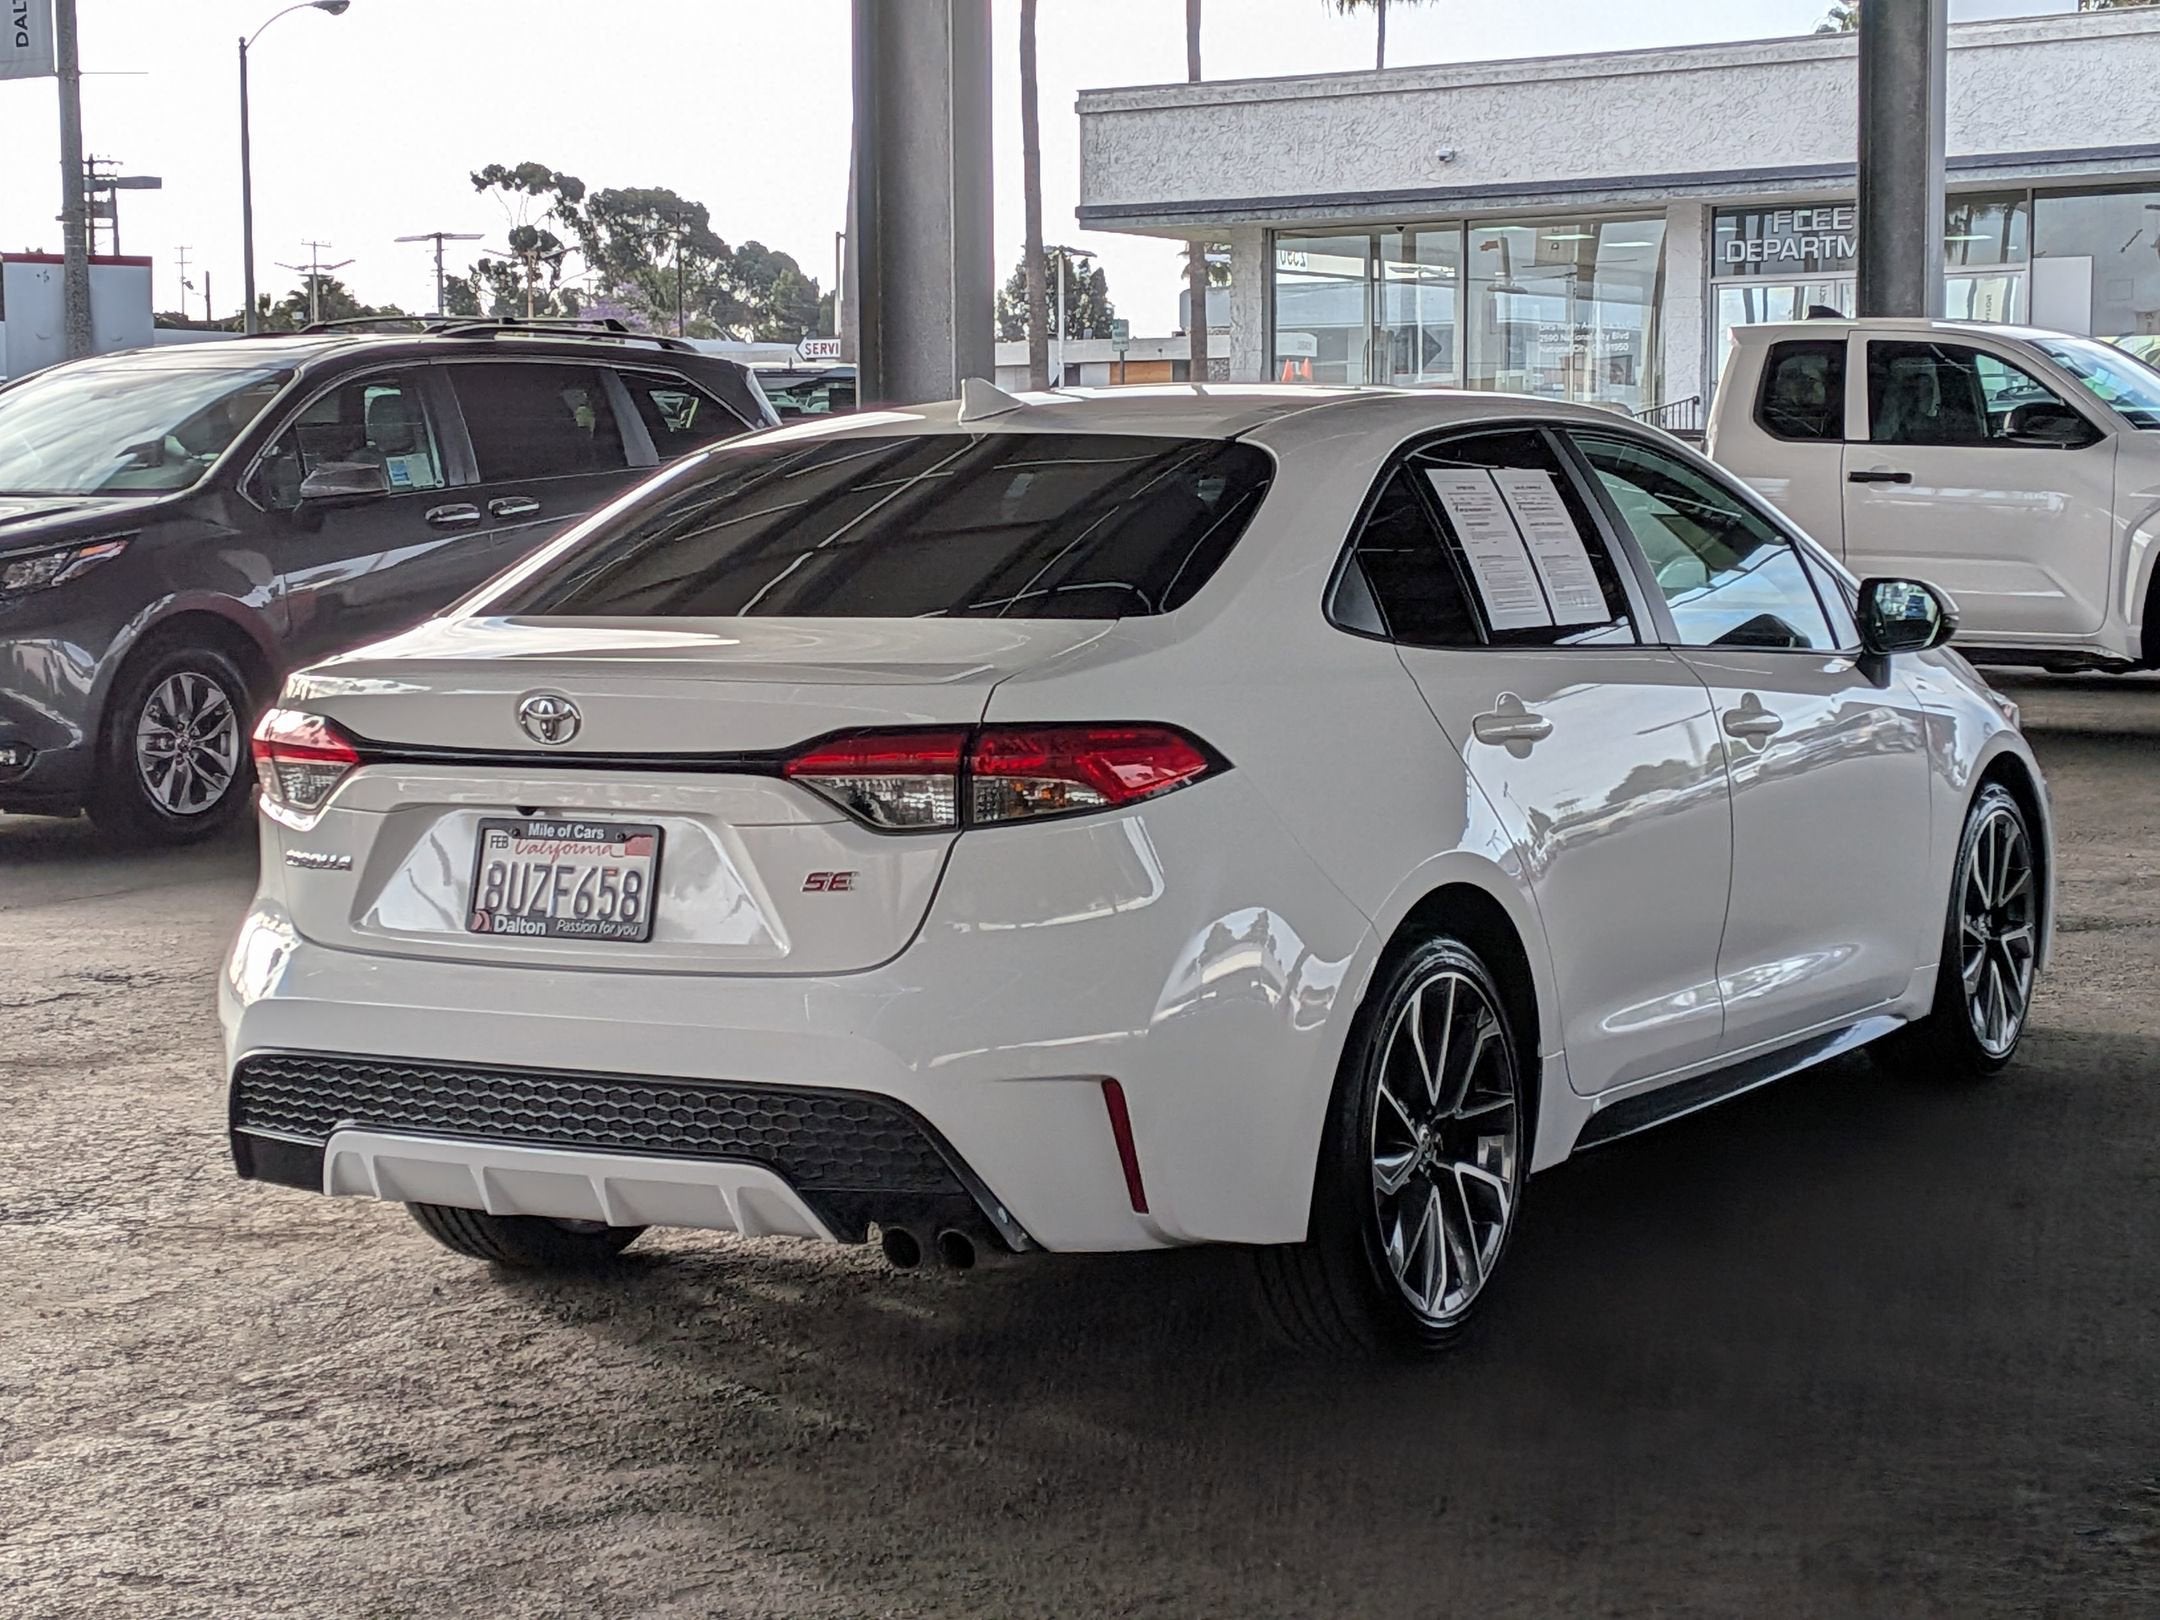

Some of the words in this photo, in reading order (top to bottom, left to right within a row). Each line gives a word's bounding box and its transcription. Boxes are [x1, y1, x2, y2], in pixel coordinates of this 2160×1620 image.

[1772, 206, 1858, 233] FLEE
[528, 822, 555, 837] Mile
[557, 824, 573, 838] of
[573, 824, 605, 840] Cars
[490, 835, 509, 849] FEB
[515, 840, 625, 864] California
[484, 860, 643, 922] 8UZF658
[801, 871, 859, 892] SE
[493, 915, 547, 936] Dalton
[555, 919, 598, 934] Passion
[598, 920, 616, 935] for
[615, 924, 639, 938] you
